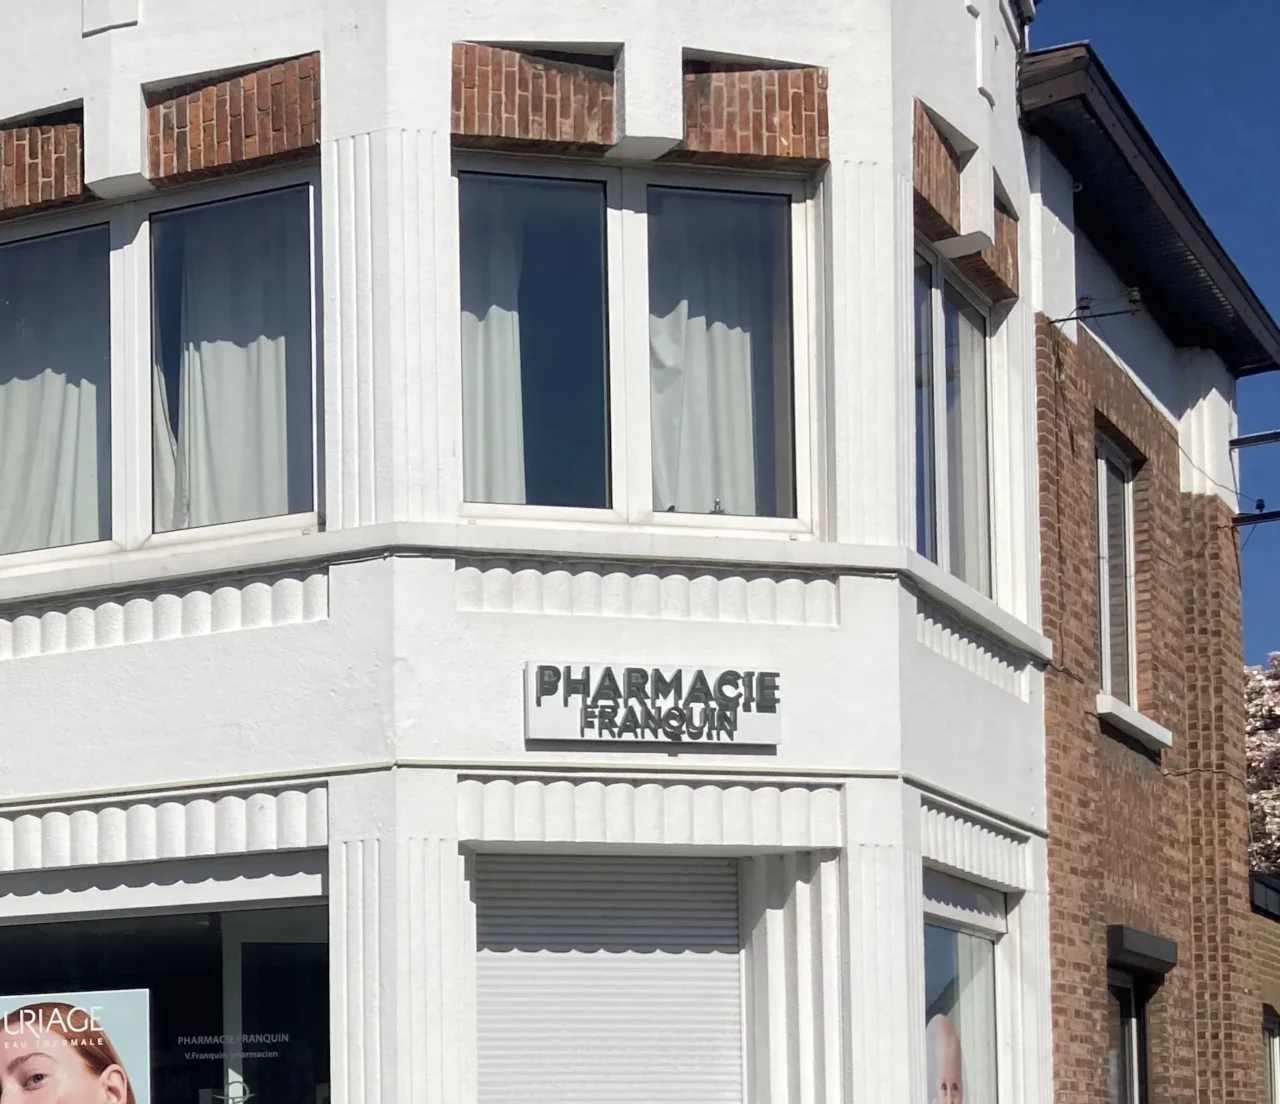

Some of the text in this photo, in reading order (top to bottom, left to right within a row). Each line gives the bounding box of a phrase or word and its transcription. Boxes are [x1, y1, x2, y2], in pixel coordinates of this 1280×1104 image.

[536, 665, 781, 708] PHARMACIE
[581, 705, 738, 740] FRANQUIN
[4, 1006, 104, 1039] URIAGE
[4, 1038, 104, 1049] EAU THERMALE
[177, 1033, 289, 1046] PHARMACIE FRANQUIN
